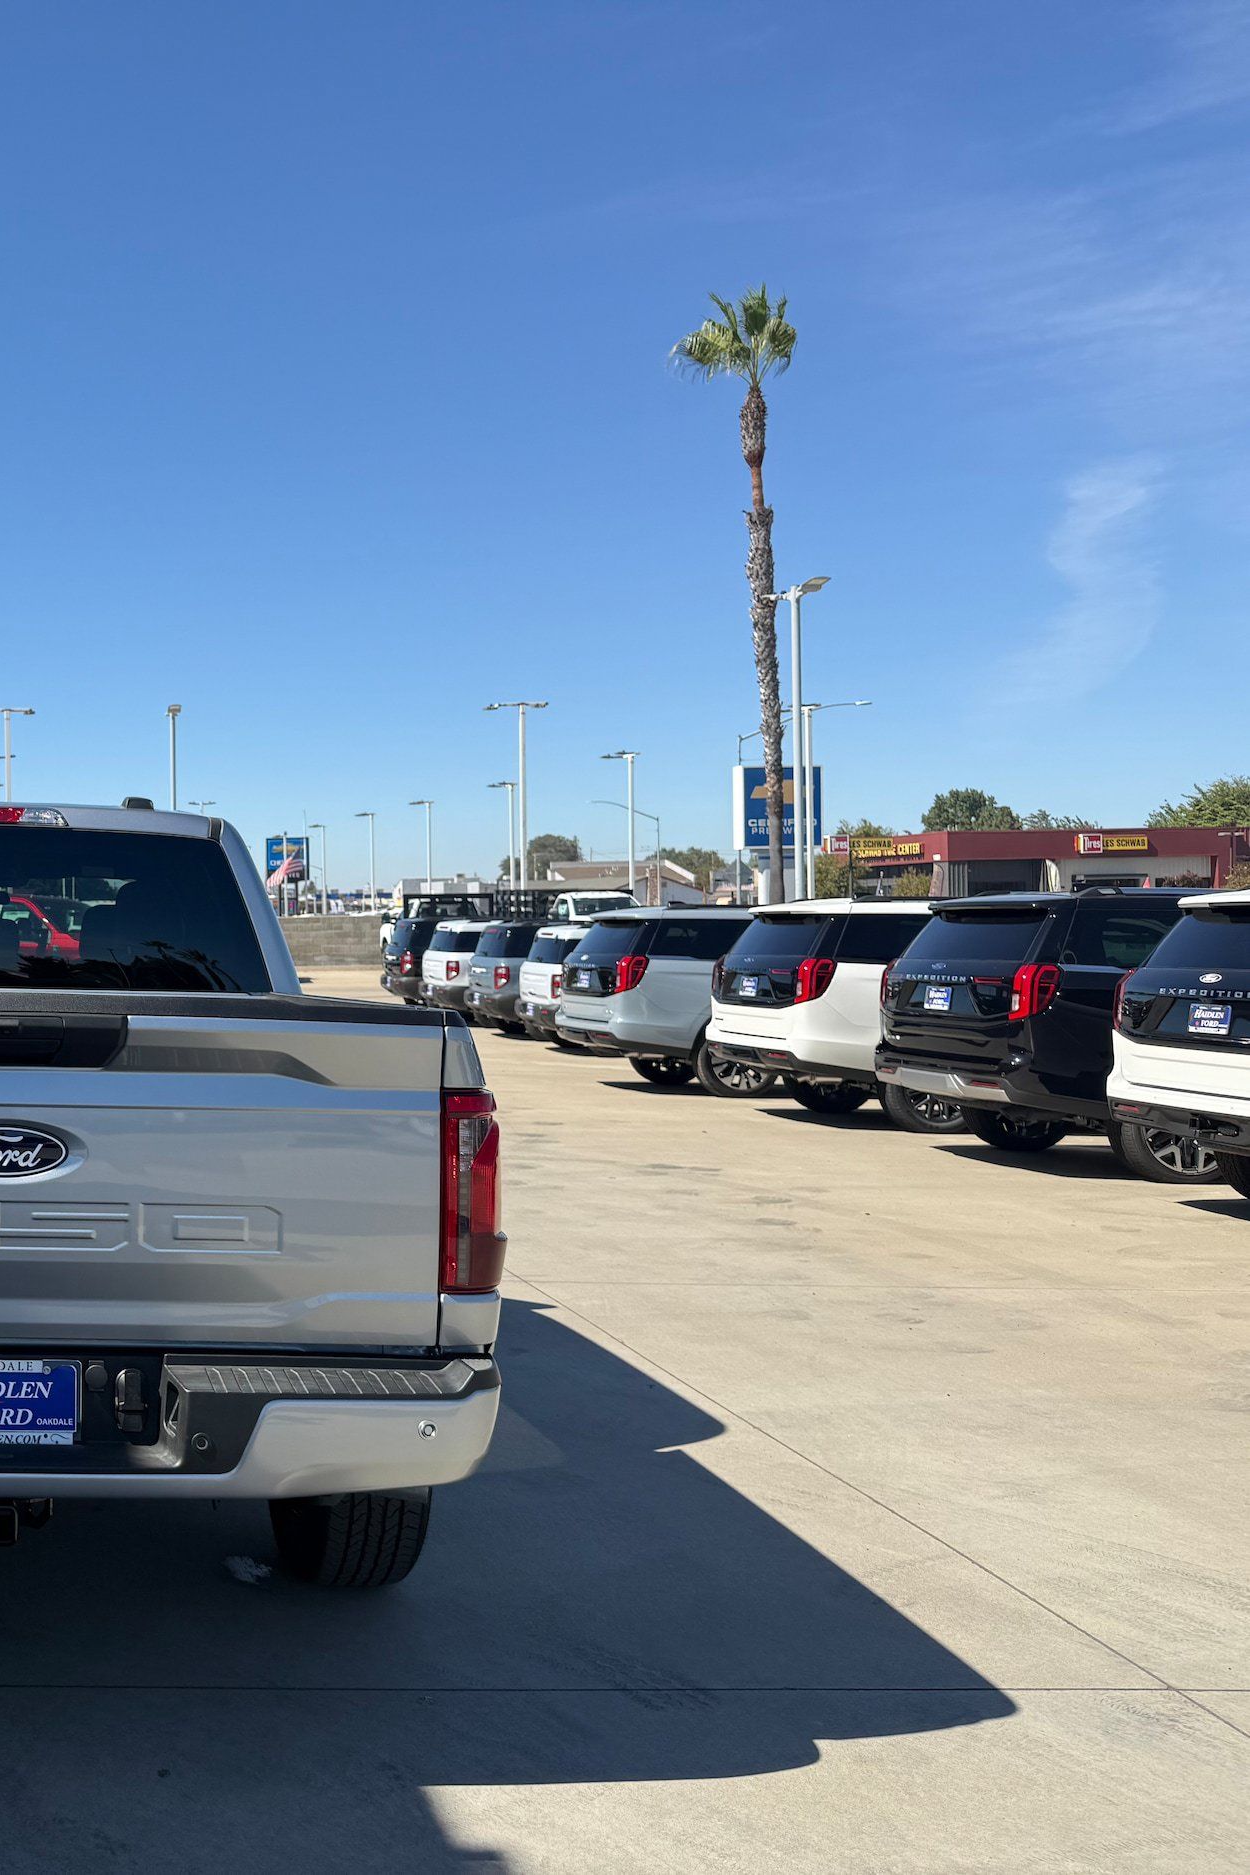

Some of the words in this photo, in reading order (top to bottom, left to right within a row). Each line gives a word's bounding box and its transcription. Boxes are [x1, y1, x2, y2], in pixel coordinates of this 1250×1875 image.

[862, 839, 892, 848] SCHWAB
[1083, 836, 1101, 850] Tires
[1102, 839, 1115, 848] LES
[1116, 839, 1146, 847] SCHWAB
[906, 973, 967, 982] EXPEDITION
[36, 1418, 74, 1426] OAKDALE
